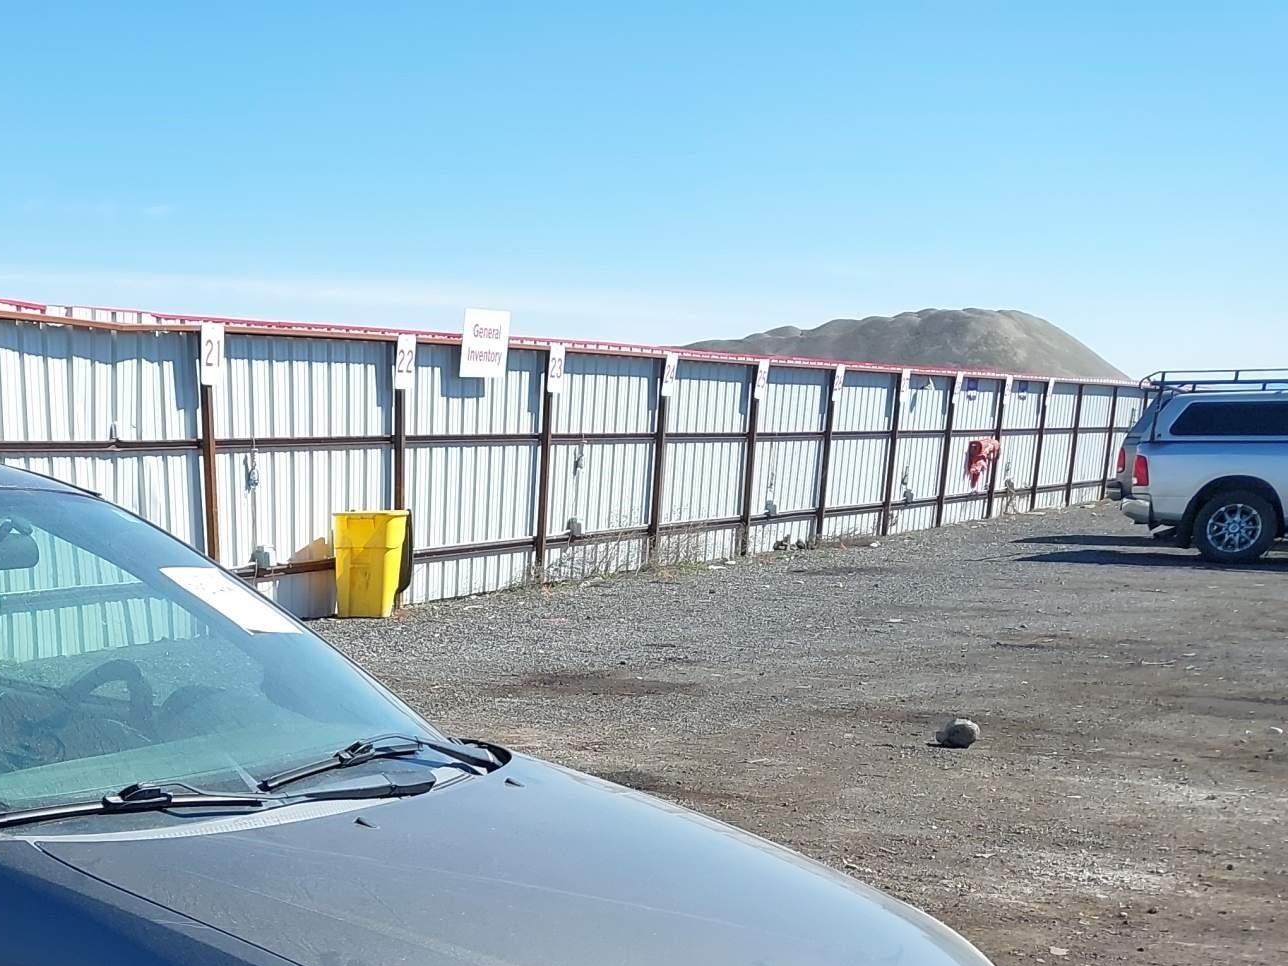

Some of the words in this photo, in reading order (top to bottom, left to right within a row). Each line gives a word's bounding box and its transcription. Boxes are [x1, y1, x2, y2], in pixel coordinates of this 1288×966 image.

[473, 323, 502, 340] General
[205, 339, 221, 367] 21
[398, 349, 413, 373] 22
[467, 346, 502, 365] Inventory
[550, 357, 563, 378] 23
[664, 364, 675, 383] 24
